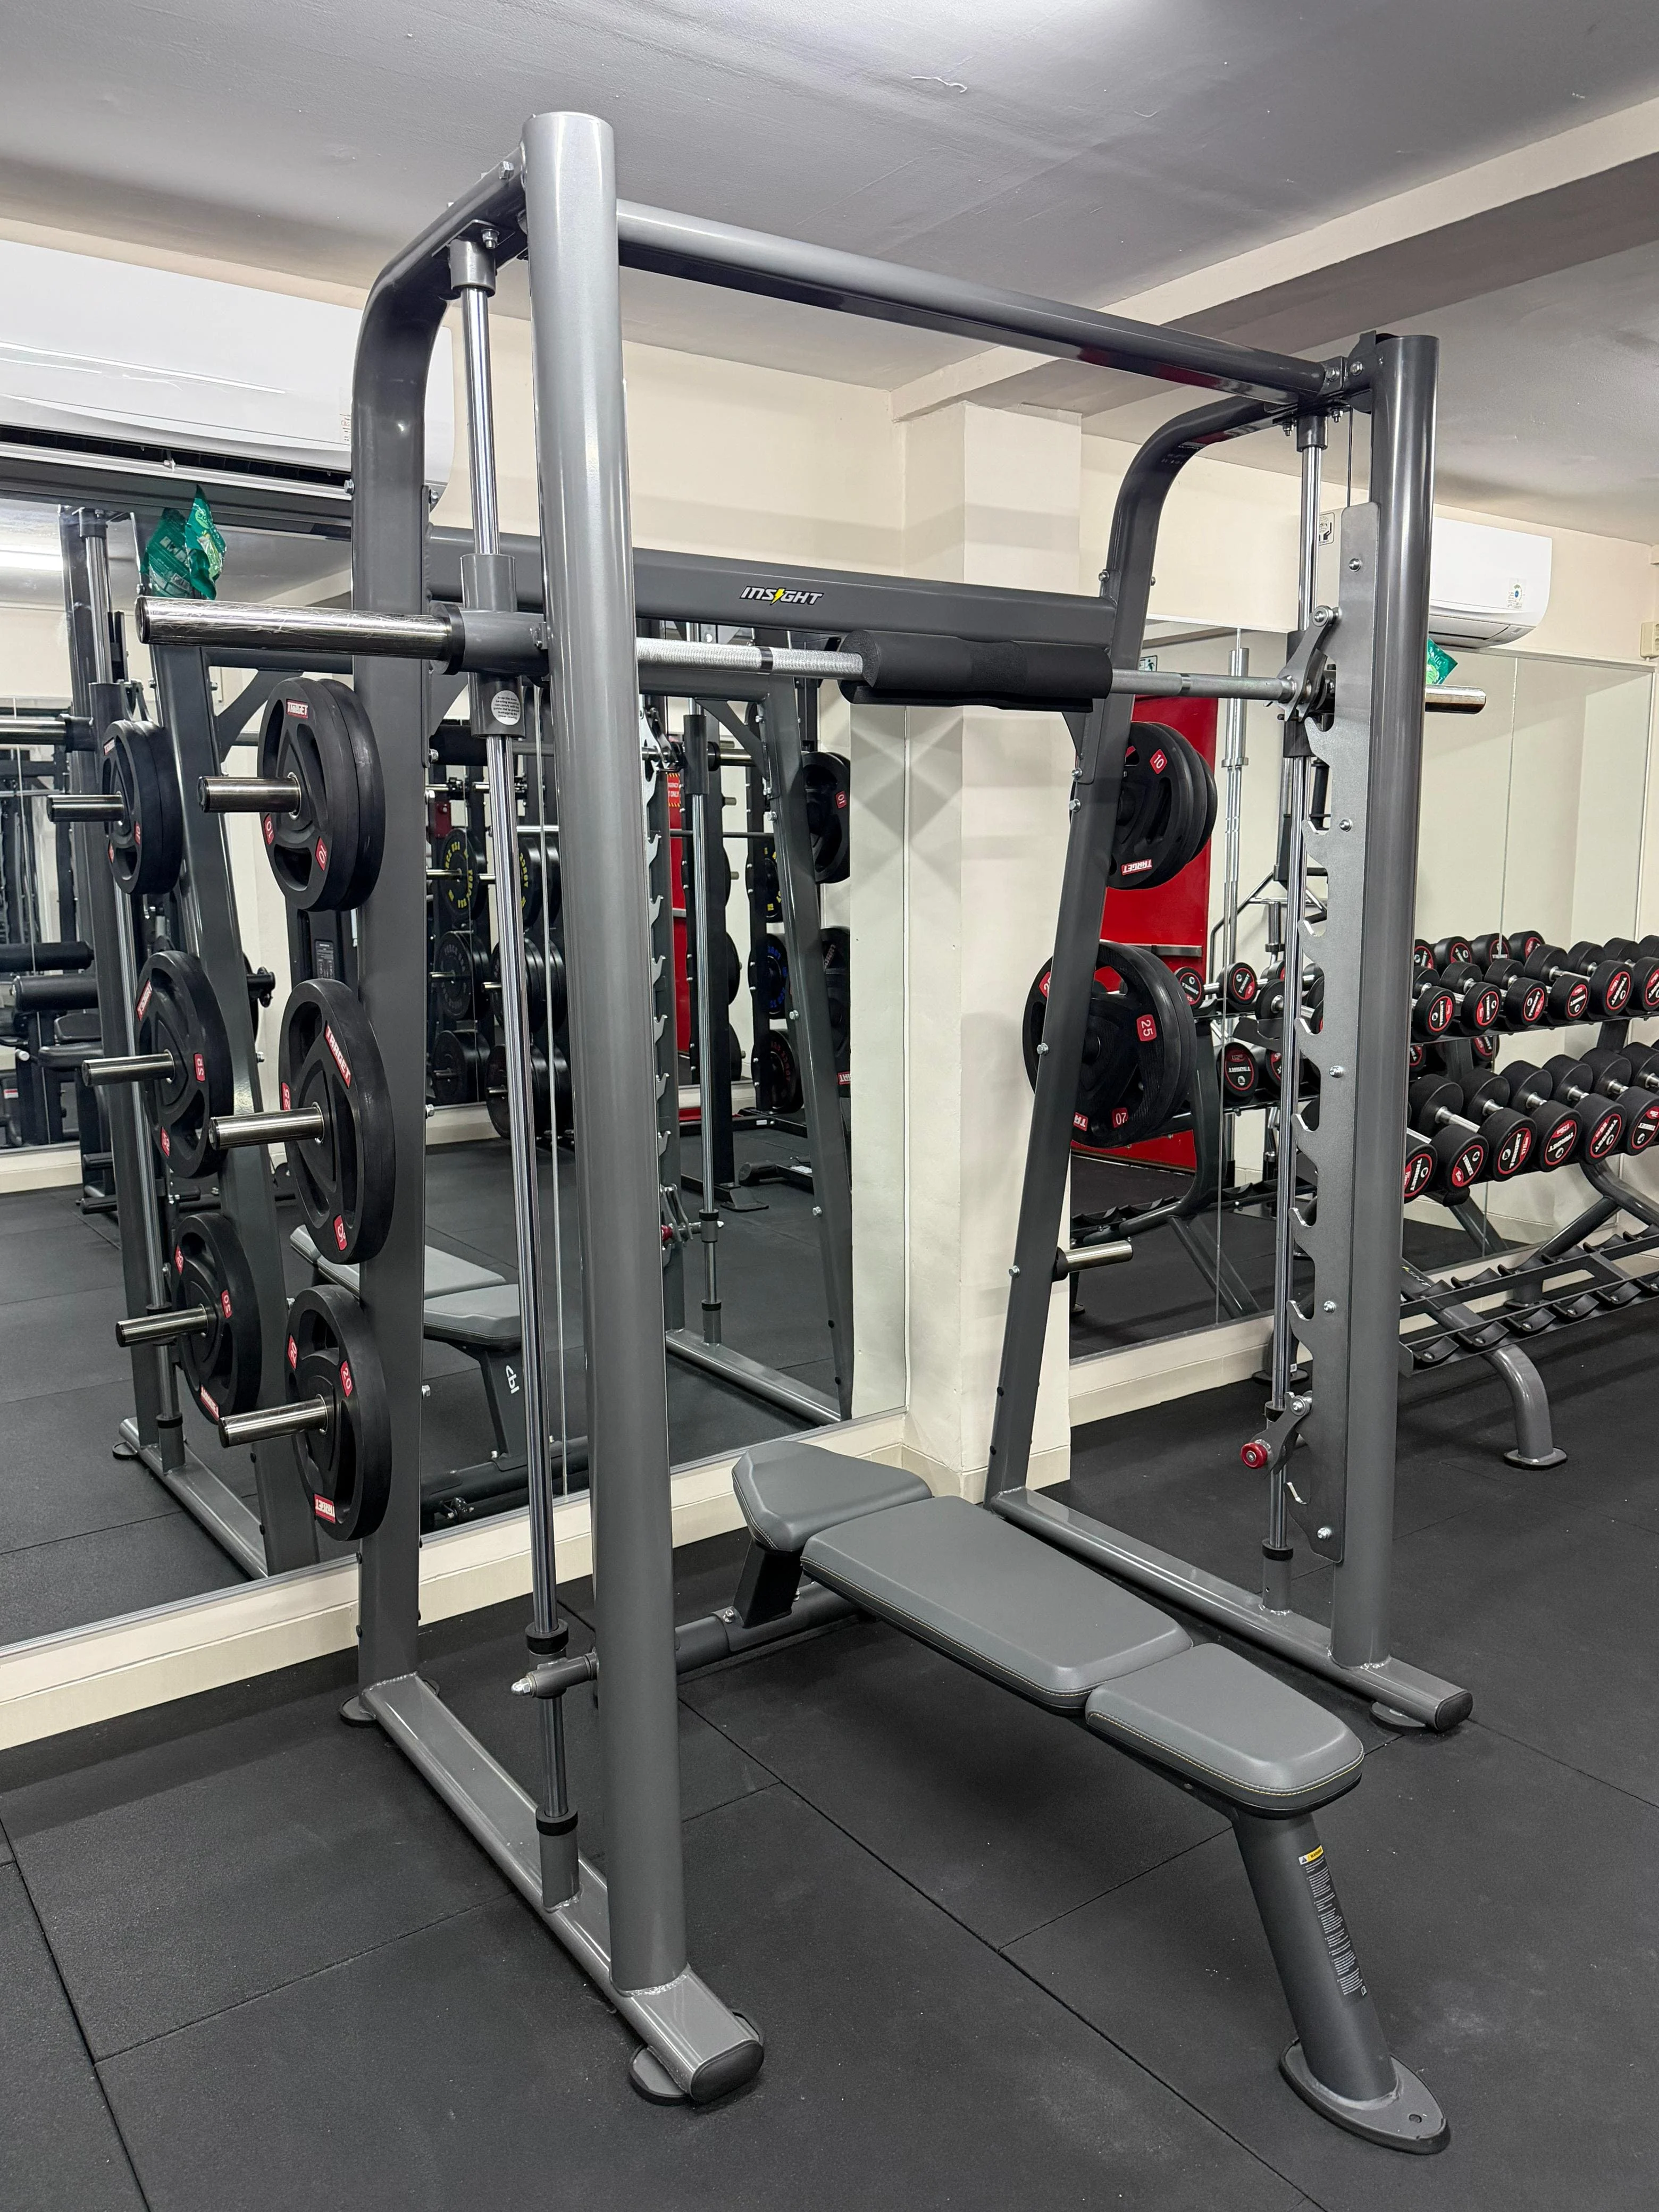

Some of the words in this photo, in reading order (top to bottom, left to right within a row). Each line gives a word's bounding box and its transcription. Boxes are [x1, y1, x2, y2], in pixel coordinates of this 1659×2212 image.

[740, 585, 824, 606] INSIGHT
[287, 701, 308, 716] TARGET
[1154, 754, 1164, 769] 10
[267, 820, 273, 839] 10
[319, 848, 327, 865] 10
[1122, 859, 1152, 873] TARGET
[1141, 1019, 1153, 1037] 25
[326, 1024, 351, 1079] TARGET
[284, 1088, 291, 1110] 25
[337, 1223, 346, 1243] 25
[290, 1341, 297, 1367] 20
[342, 1367, 352, 1390] 20
[315, 1498, 336, 1518] TARGET
